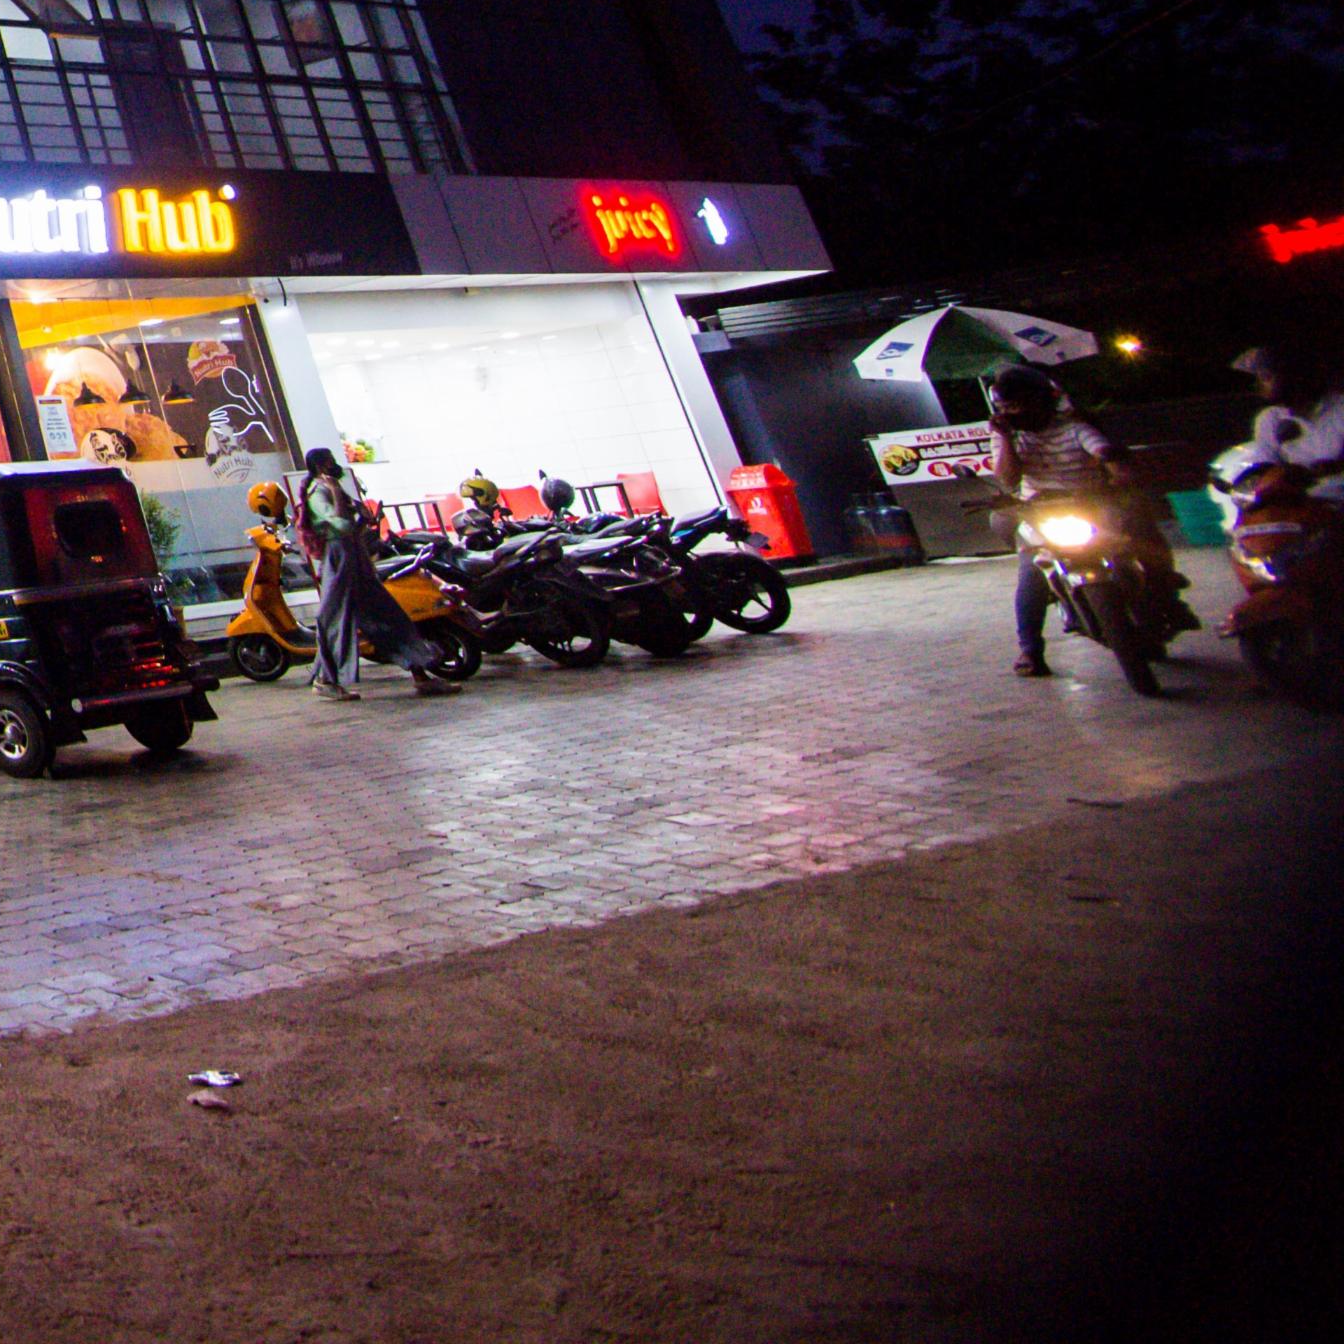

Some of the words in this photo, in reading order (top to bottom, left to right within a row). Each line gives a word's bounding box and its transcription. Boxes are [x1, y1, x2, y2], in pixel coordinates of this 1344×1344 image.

[118, 188, 235, 254] Hub
[915, 430, 965, 443] KOLKATA
[213, 461, 233, 478] Nutri
[234, 457, 253, 467] Hub
